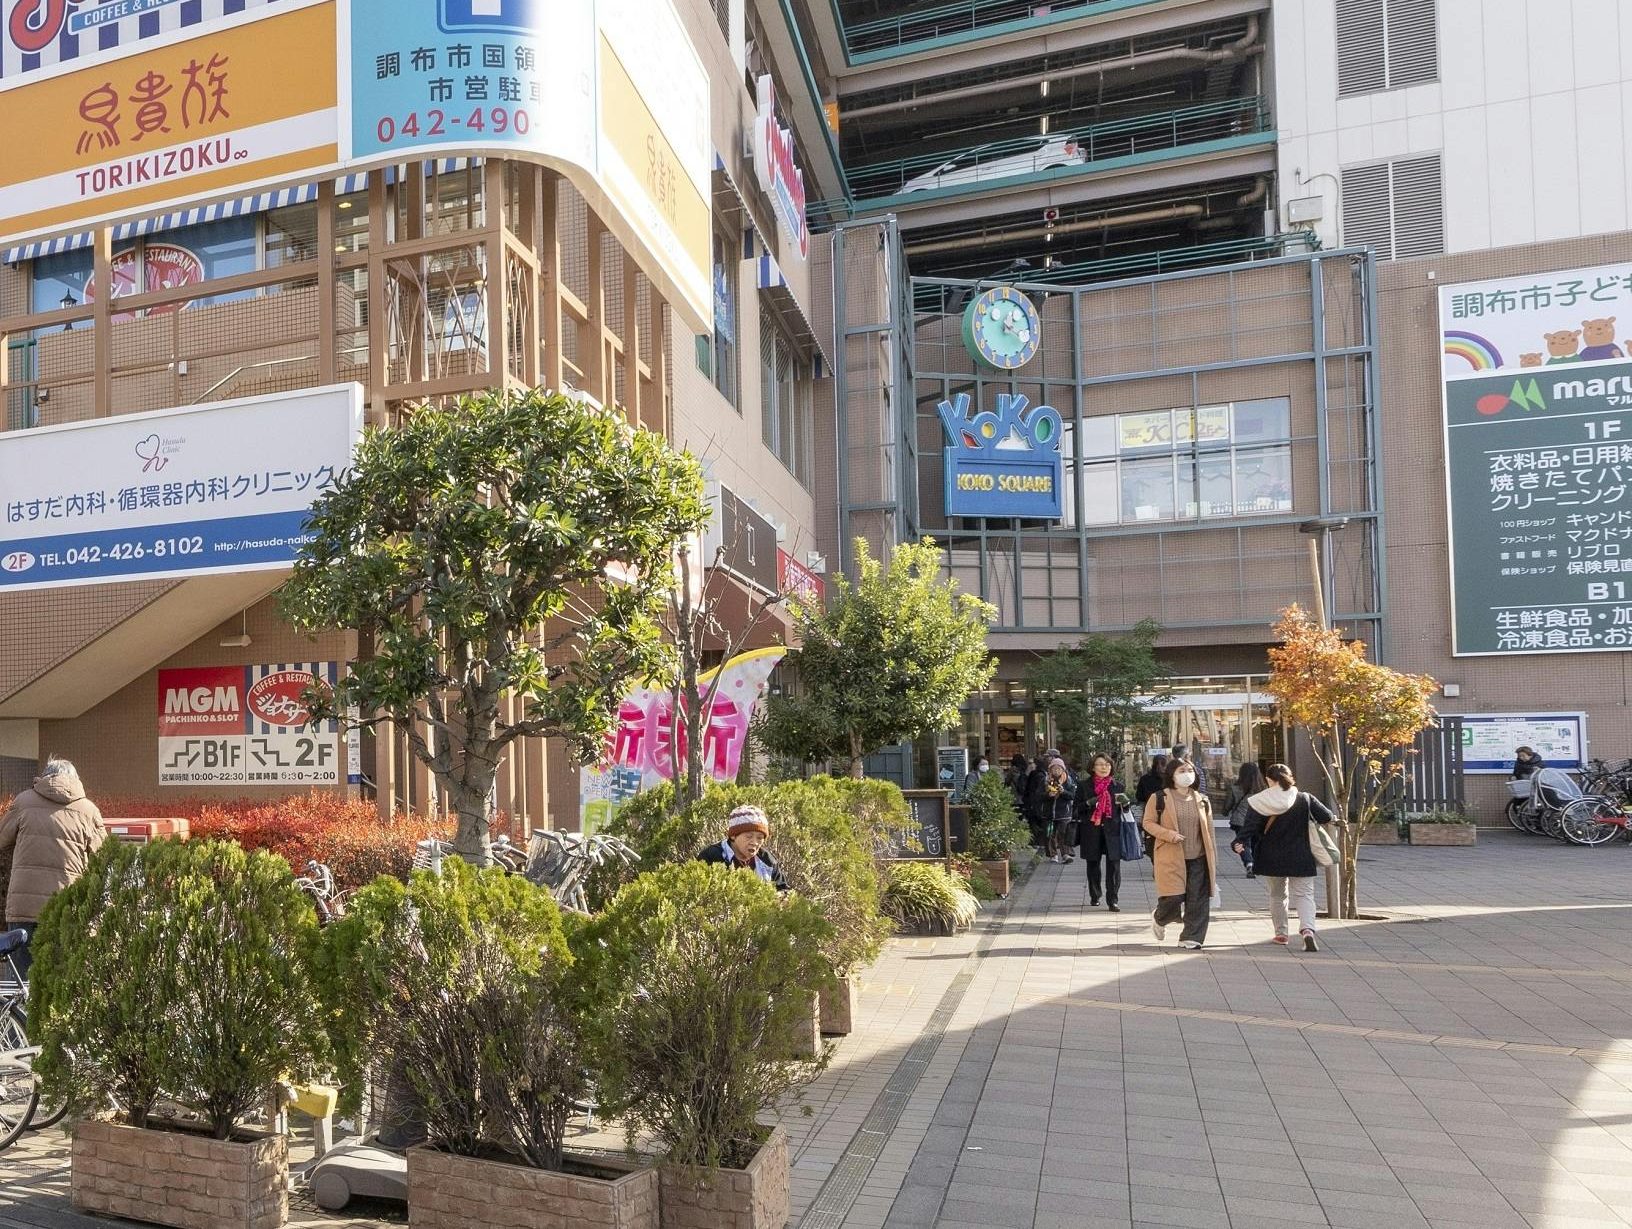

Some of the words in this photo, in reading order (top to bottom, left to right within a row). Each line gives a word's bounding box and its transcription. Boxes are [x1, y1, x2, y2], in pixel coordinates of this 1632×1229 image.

[84, 2, 128, 26] COFFEE
[1584, 419, 1621, 439] 1F
[956, 474, 994, 492] KOKO
[998, 474, 1052, 493] SQUARE
[1490, 465, 1632, 492] 焼きたてパ
[7, 465, 334, 523] はすだ内科・循環器内科クリニック
[1491, 484, 1628, 511] クリーニング
[1499, 533, 1556, 544] ファストフード
[8, 554, 28, 570] 2F
[40, 536, 203, 567] TEL.042-426-8102
[1568, 543, 1620, 559] リブロ
[1497, 628, 1632, 650] 冷凍食品・お
[253, 676, 277, 696] COFFEE
[164, 686, 239, 714] MGM
[166, 714, 239, 724] PACHINKO&SLOT
[203, 740, 241, 768] B1F
[295, 738, 333, 767] 2F
[161, 773, 189, 782] 営業時間
[248, 772, 278, 781] 営業時間
[588, 774, 613, 786] NEW
